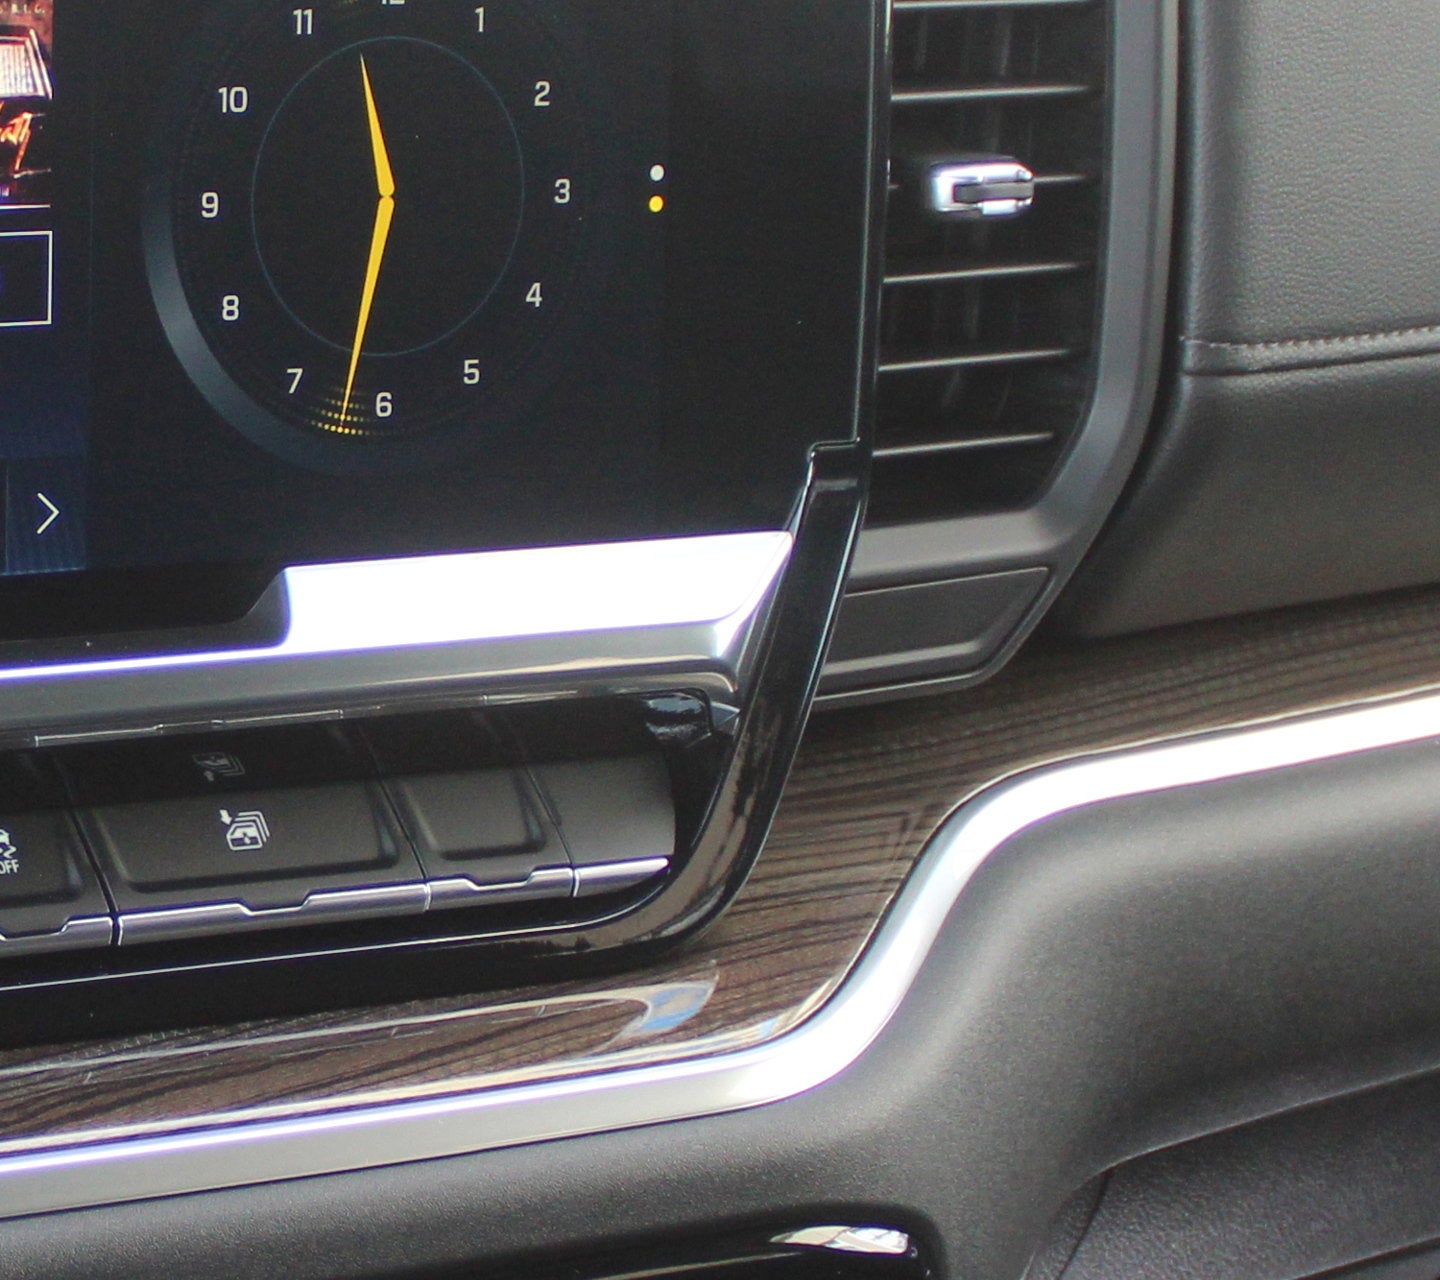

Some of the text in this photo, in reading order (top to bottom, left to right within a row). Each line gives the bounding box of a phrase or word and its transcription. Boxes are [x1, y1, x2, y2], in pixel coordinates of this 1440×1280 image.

[292, 8, 313, 35] 11
[474, 6, 484, 33] 1
[218, 86, 248, 113] 10
[534, 80, 550, 107] 2
[201, 191, 219, 218] 9
[554, 178, 571, 204] 3
[222, 294, 240, 321] 8
[525, 282, 543, 308] 4
[286, 367, 303, 394] 7
[463, 359, 480, 385] 5
[375, 391, 393, 418] 6
